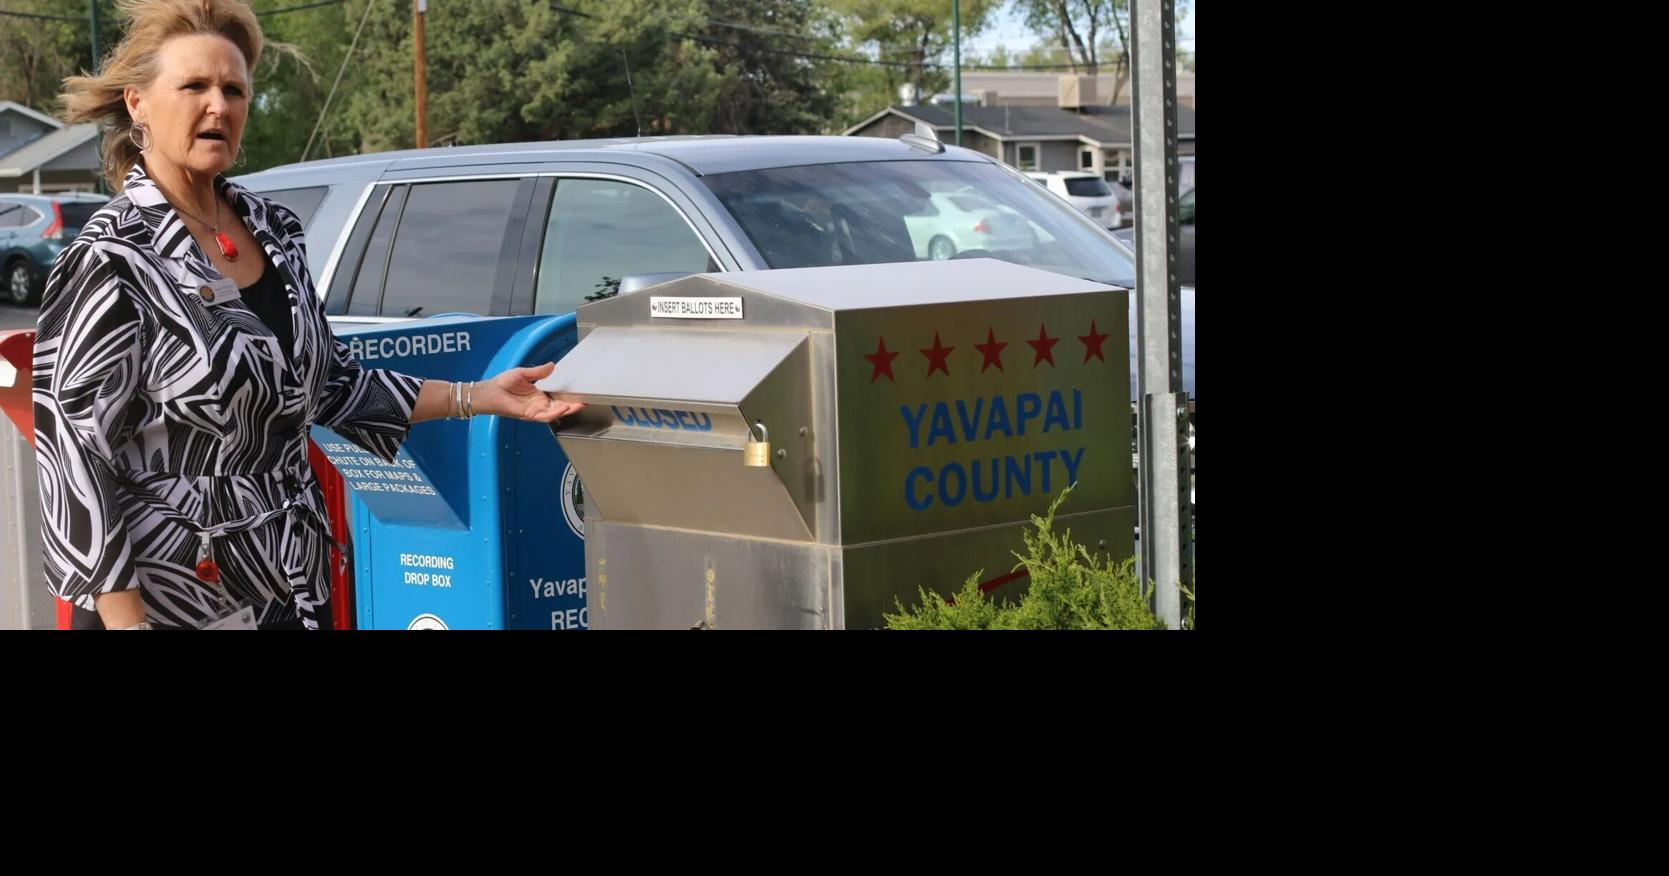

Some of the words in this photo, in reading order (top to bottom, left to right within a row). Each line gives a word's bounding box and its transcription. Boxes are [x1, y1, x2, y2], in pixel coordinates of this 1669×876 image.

[658, 301, 680, 313] INSERT
[681, 302, 713, 314] BALLOTS
[714, 302, 734, 314] HERE
[350, 331, 471, 361] RECORDER
[900, 388, 1083, 448] YAVAPAI
[323, 443, 345, 453] USE
[344, 444, 370, 454] PUL
[327, 455, 359, 466] CHUTE
[359, 457, 375, 467] ON
[402, 460, 417, 469] OF
[342, 469, 366, 479] BOX
[365, 470, 384, 479] FOR
[384, 471, 412, 481] MAPS
[412, 473, 423, 482] &
[904, 447, 1086, 512] COUNTY
[349, 481, 384, 492] LARGE
[383, 483, 436, 496] PACKAGES
[400, 553, 454, 570] RECORDING
[404, 572, 430, 586] DROP
[431, 574, 452, 588] BOX
[530, 577, 587, 599] Yavap
[551, 607, 588, 630] REC
